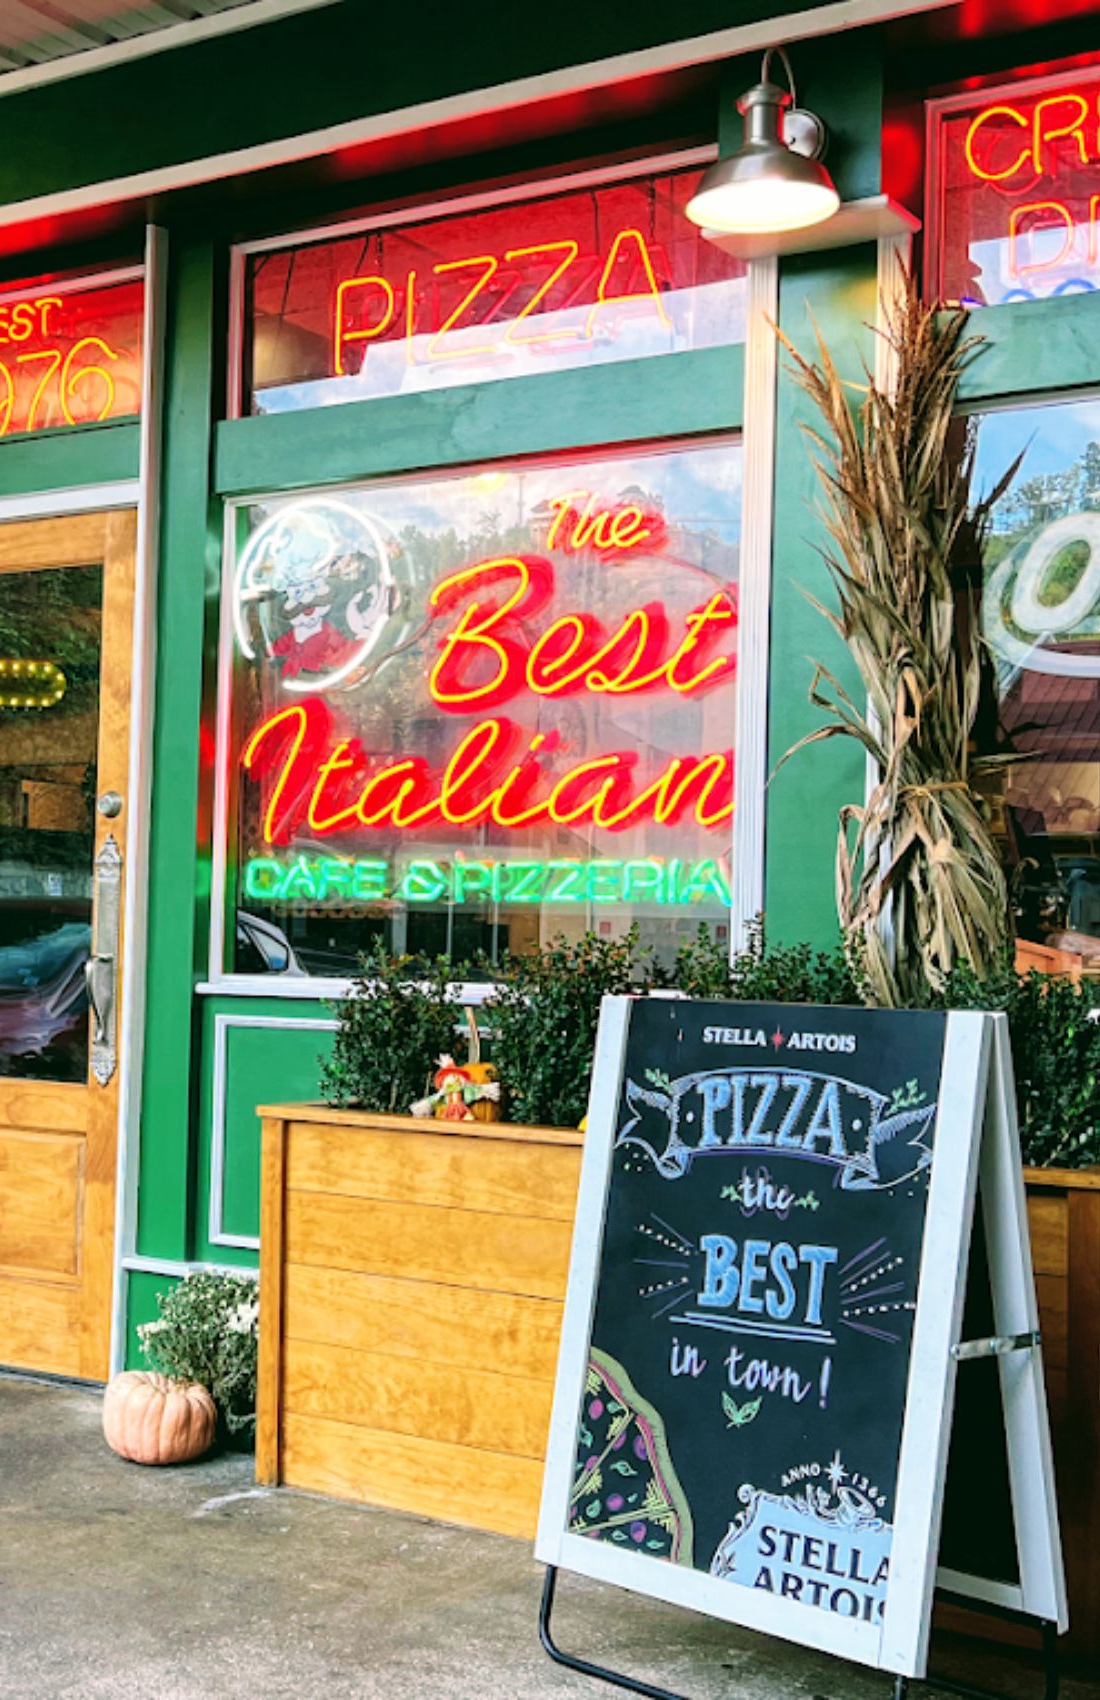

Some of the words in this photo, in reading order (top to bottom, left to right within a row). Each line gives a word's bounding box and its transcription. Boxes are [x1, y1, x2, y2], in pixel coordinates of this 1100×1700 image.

[965, 95, 1100, 178] CR
[334, 229, 672, 375] PIZZA
[547, 490, 651, 551] The
[429, 557, 734, 703] Best
[243, 705, 734, 844] Italian
[245, 856, 388, 900] CAFE
[400, 857, 448, 903] &
[453, 856, 734, 907] PIZZERIA
[703, 1026, 767, 1047] STELLA
[787, 1032, 856, 1053] ARTOIS
[697, 1073, 847, 1157] PIZZA
[738, 1170, 796, 1214] the
[697, 1235, 838, 1326] BEST
[669, 1337, 707, 1378] in
[781, 1462, 821, 1488] ANNO
[852, 1473, 887, 1507] 1366
